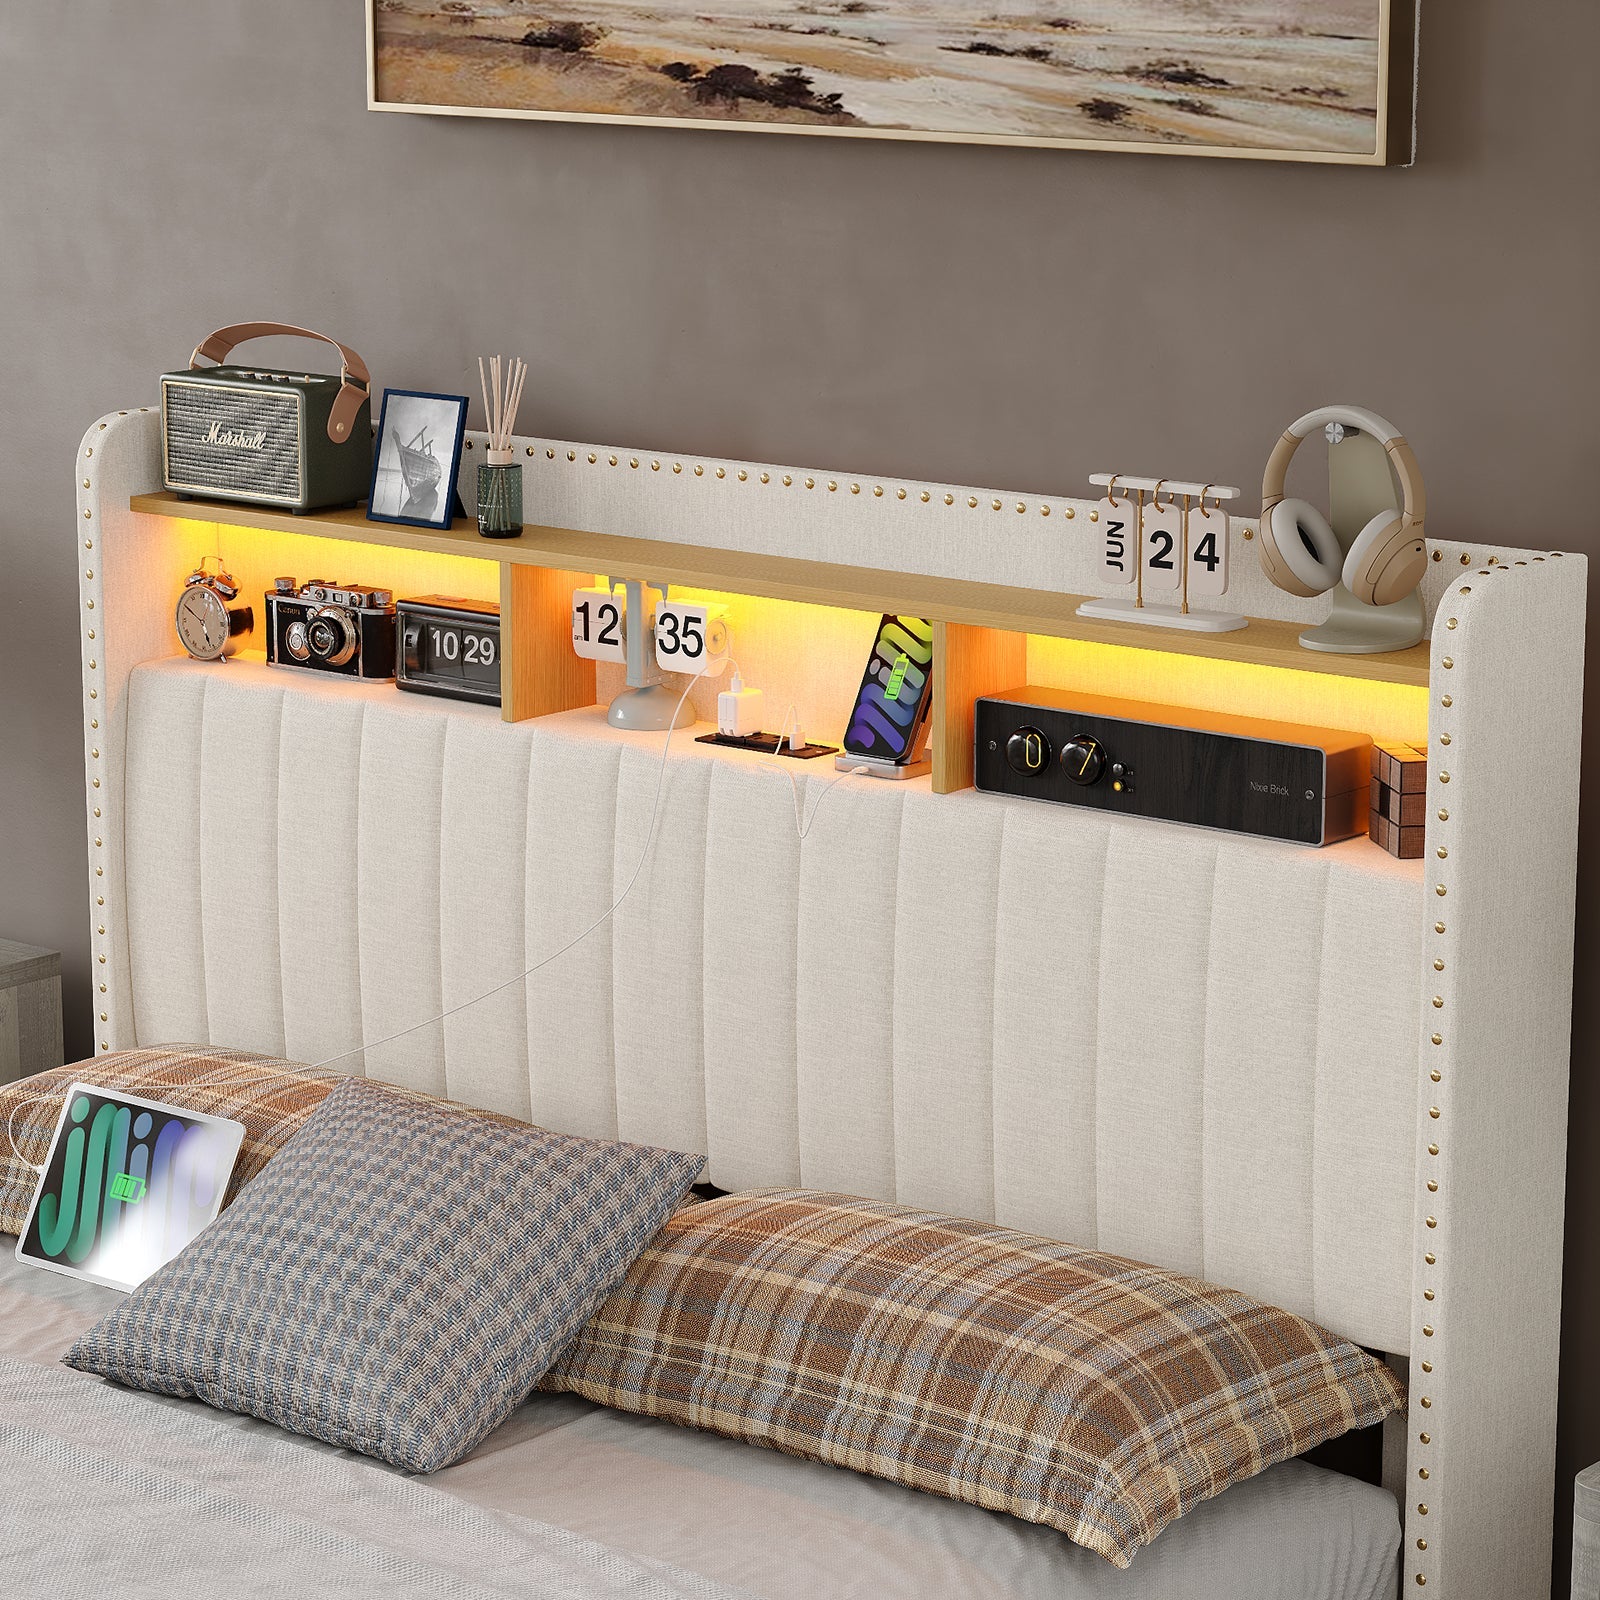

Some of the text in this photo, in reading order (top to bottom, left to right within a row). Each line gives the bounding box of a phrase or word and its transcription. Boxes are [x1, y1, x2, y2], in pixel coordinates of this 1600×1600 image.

[202, 420, 267, 449] Marshall
[1106, 520, 1125, 572] JUN
[432, 629, 495, 666] 10 29
[575, 601, 704, 658] 12 35
